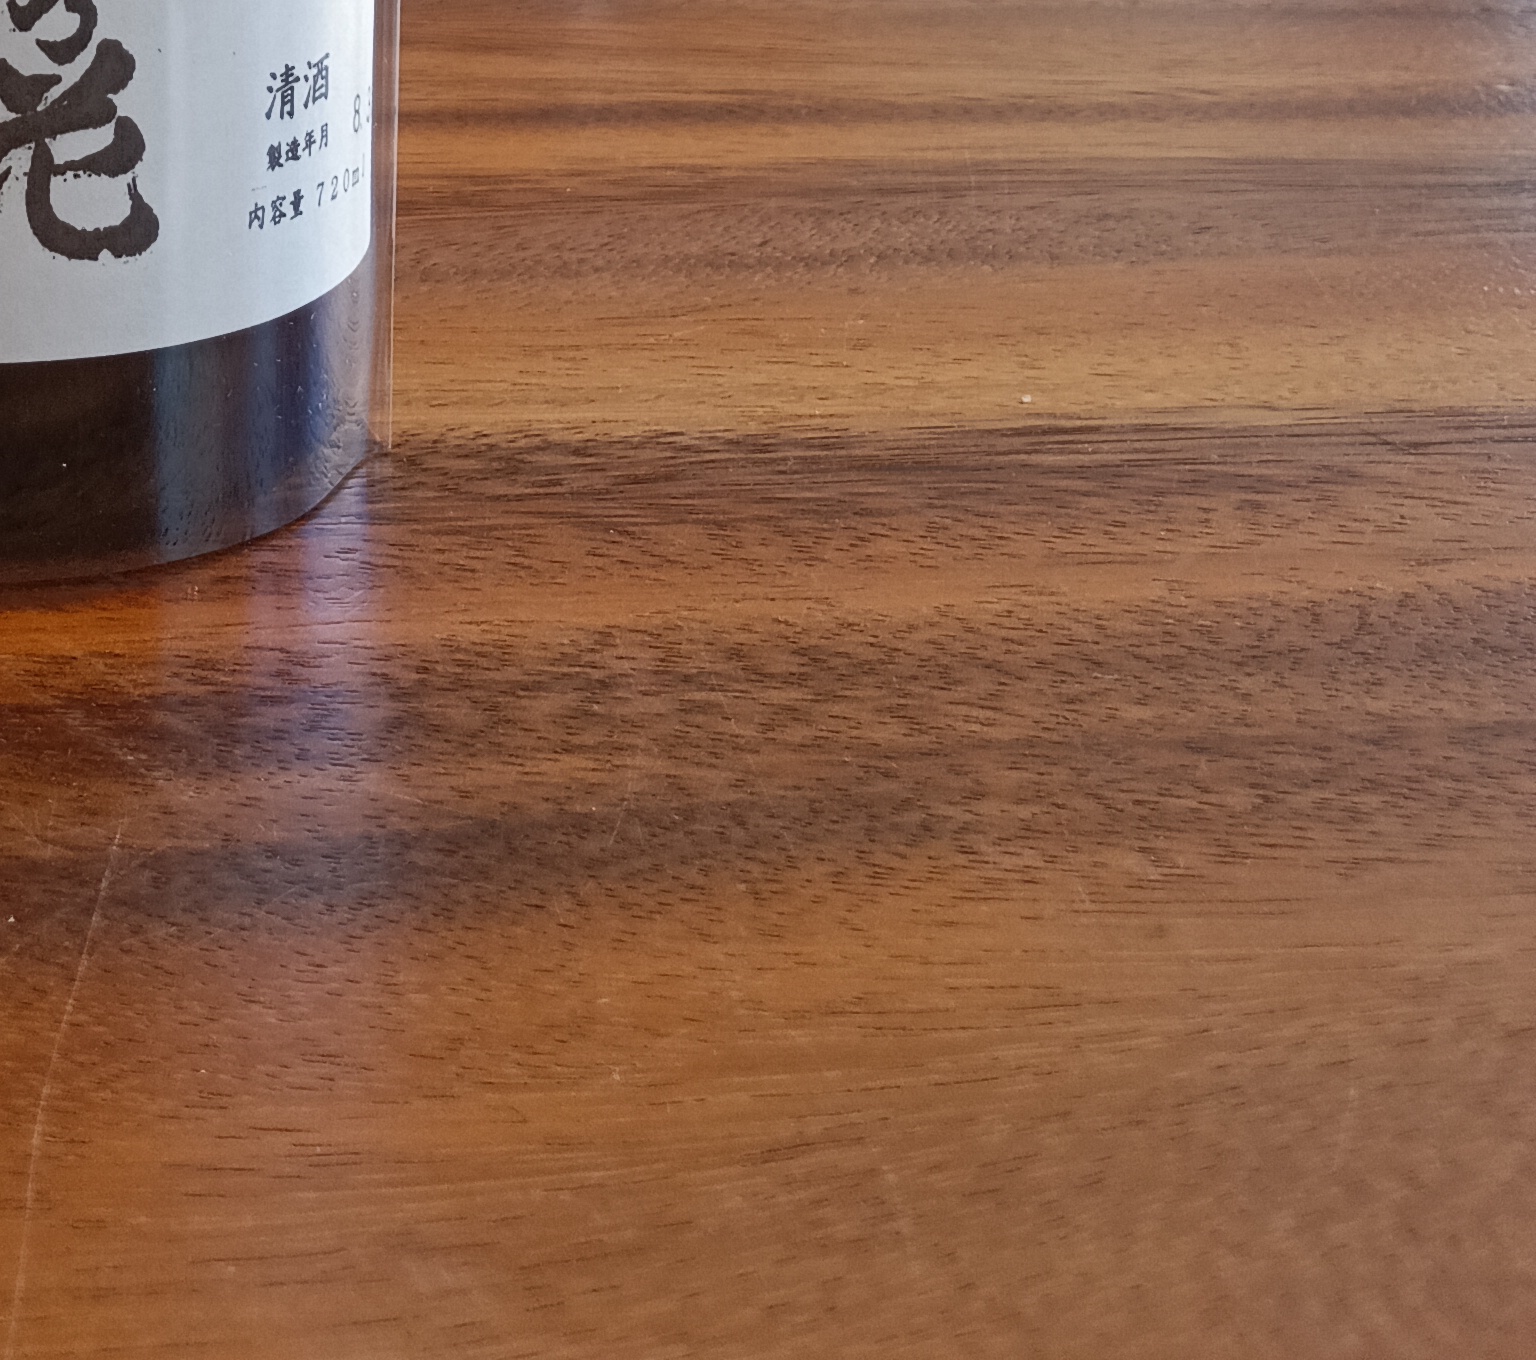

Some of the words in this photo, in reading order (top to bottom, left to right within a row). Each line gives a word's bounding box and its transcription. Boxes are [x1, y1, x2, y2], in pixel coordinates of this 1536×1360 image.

[265, 52, 331, 121] 清酒
[266, 122, 330, 172] 製造年月
[248, 188, 305, 230] 内容量
